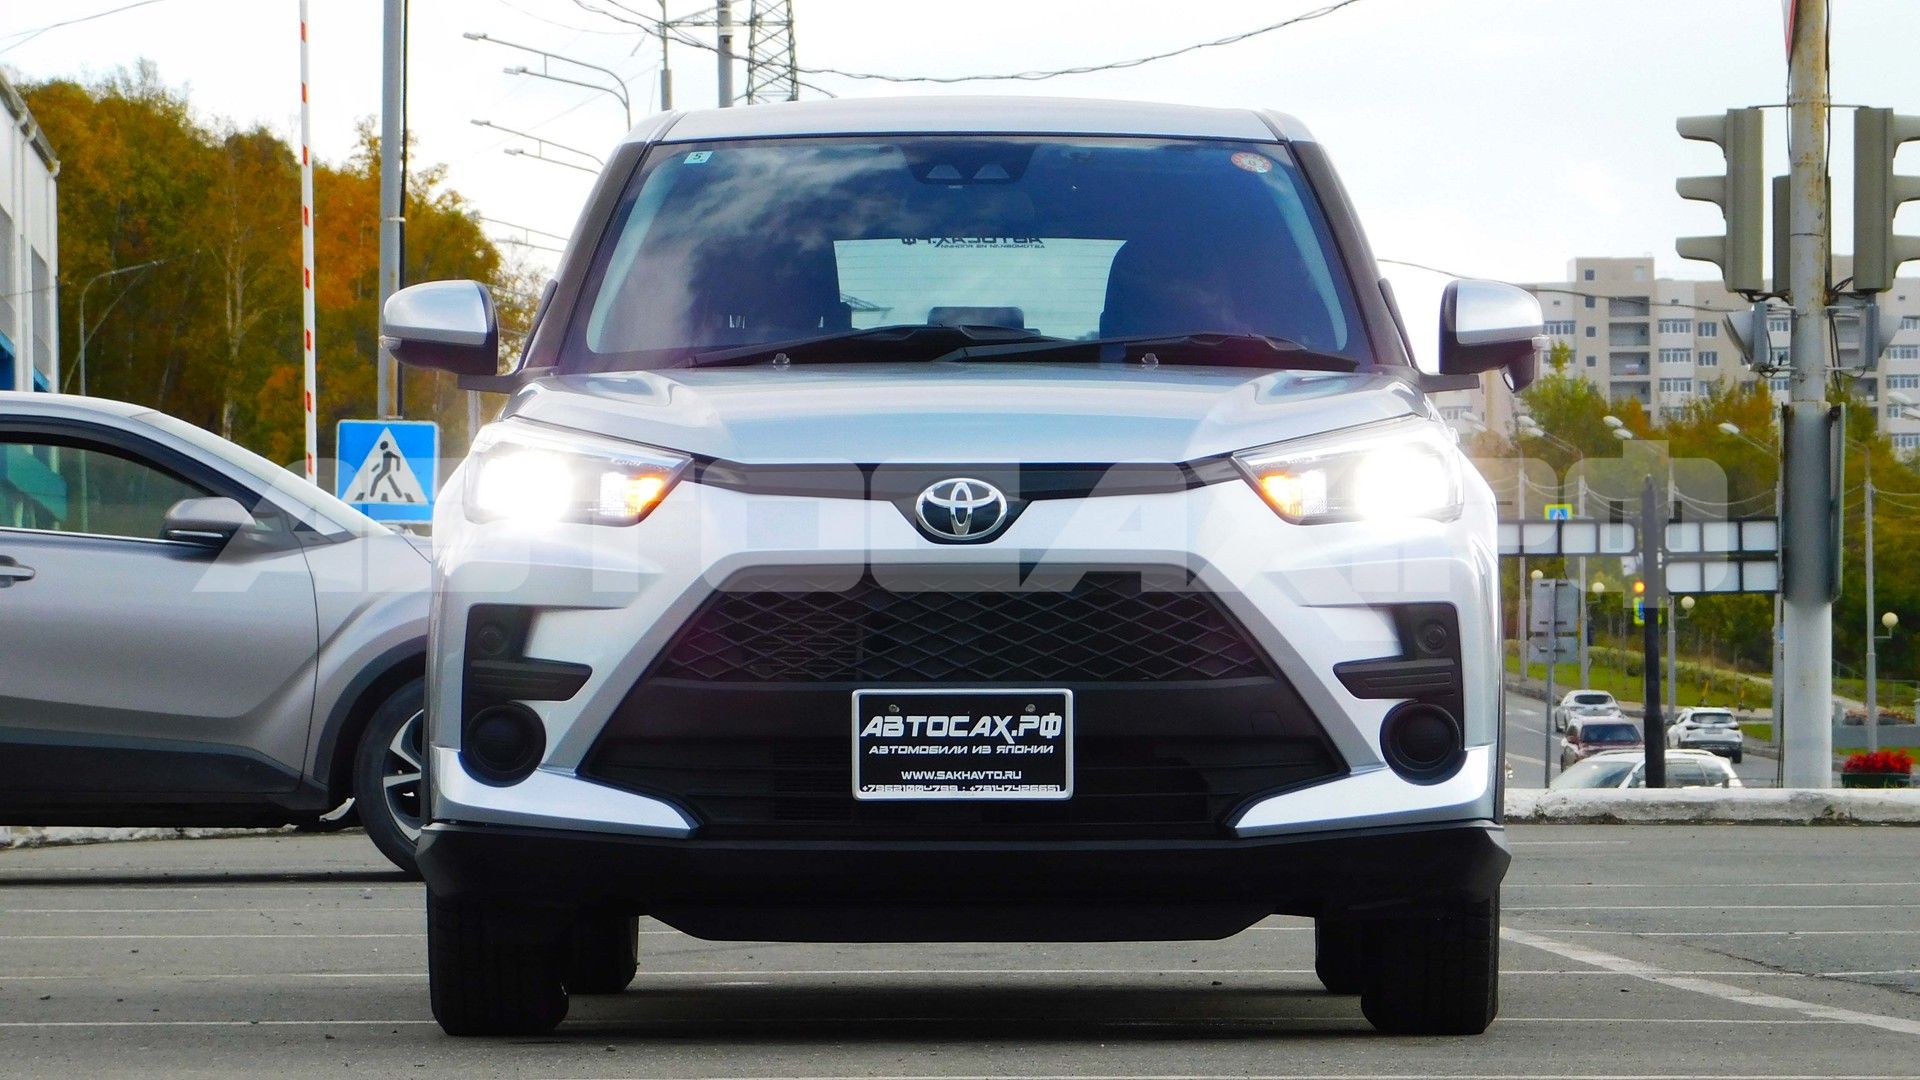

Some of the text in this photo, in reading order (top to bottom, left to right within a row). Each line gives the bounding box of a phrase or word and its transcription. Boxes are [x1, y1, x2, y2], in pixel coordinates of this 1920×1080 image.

[860, 712, 1063, 744] АВТОСАХ.РФ
[869, 745, 1054, 755] АВТОМОБИЛИ ИЗ ЯПОНИИ
[901, 770, 1022, 780] WWW.SAKHAVTO.RU
